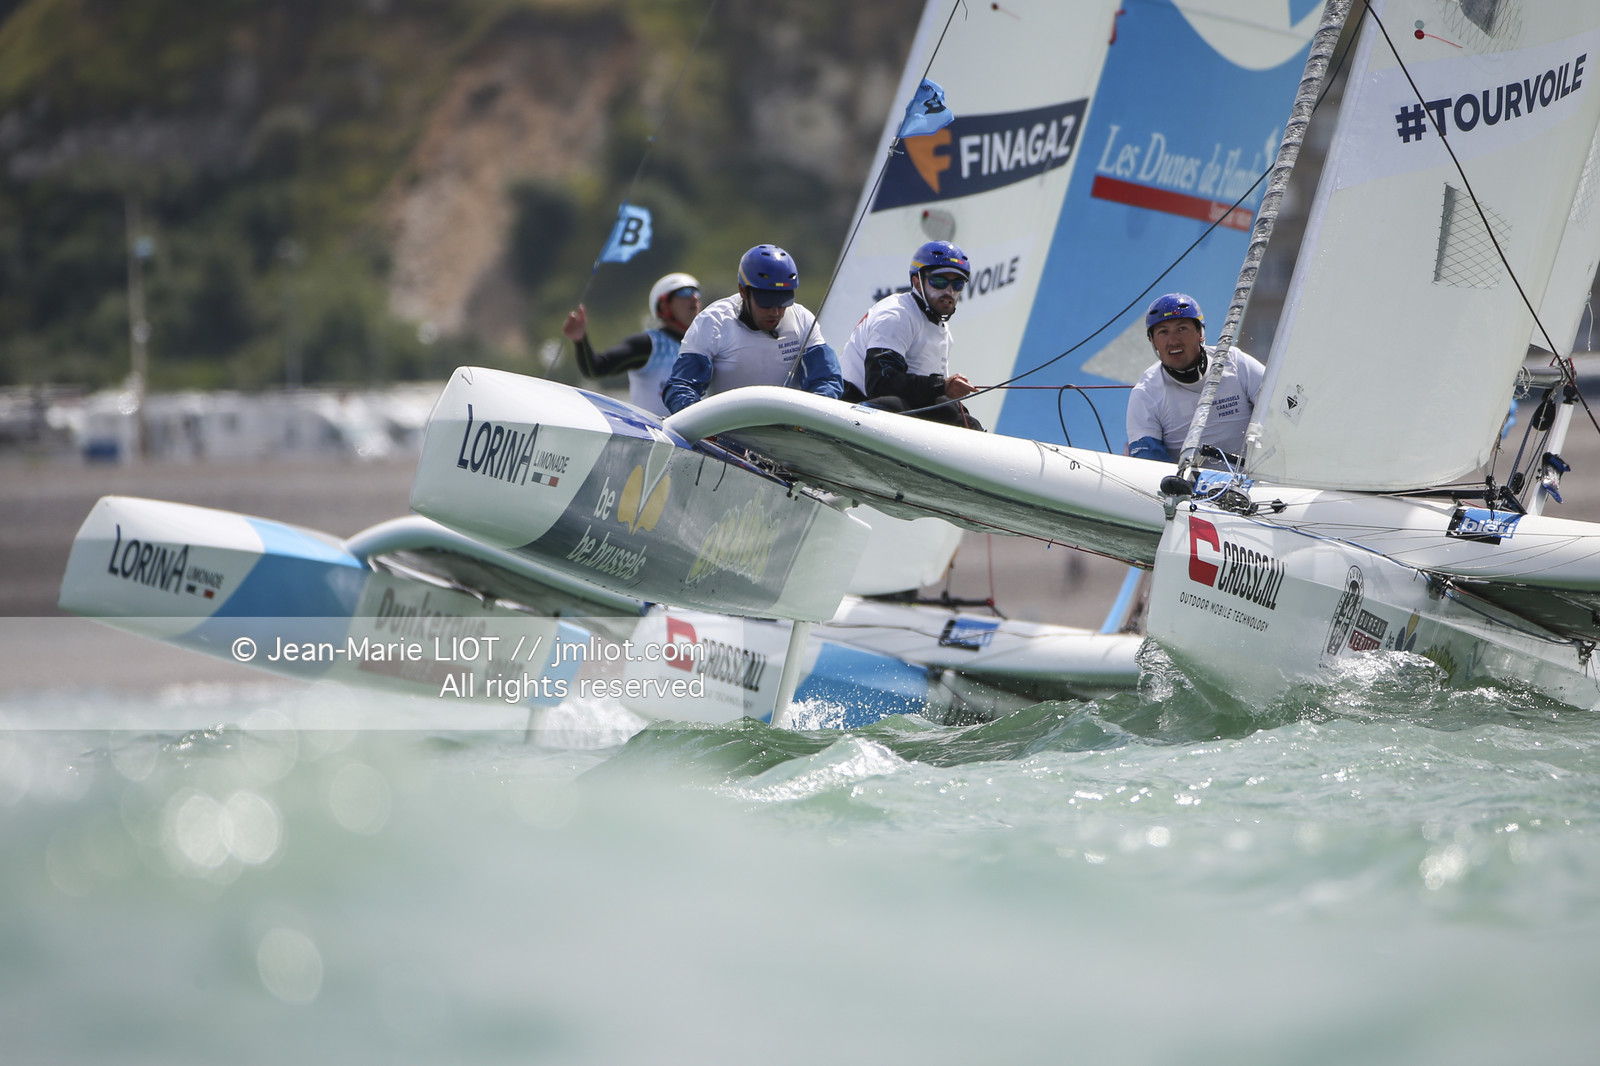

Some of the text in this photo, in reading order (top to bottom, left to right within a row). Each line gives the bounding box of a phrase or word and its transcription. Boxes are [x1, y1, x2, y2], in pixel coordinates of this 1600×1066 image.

[1395, 53, 1587, 143] #TOURVOILE
[959, 114, 1076, 179] FINAGAZ
[1097, 125, 1141, 178] Les
[1137, 132, 1201, 191] Dunes
[619, 217, 644, 246] B
[457, 403, 540, 486] LORINA
[533, 450, 570, 474] LIMONADE
[593, 476, 616, 521] be
[108, 523, 190, 594] LORINA
[566, 524, 647, 580] be.brussels
[1217, 541, 1285, 611] CROSSCALL
[1179, 591, 1270, 633] OUTDOOR MOBILE TECHNOLOGY
[1358, 612, 1386, 640] BUREAU
